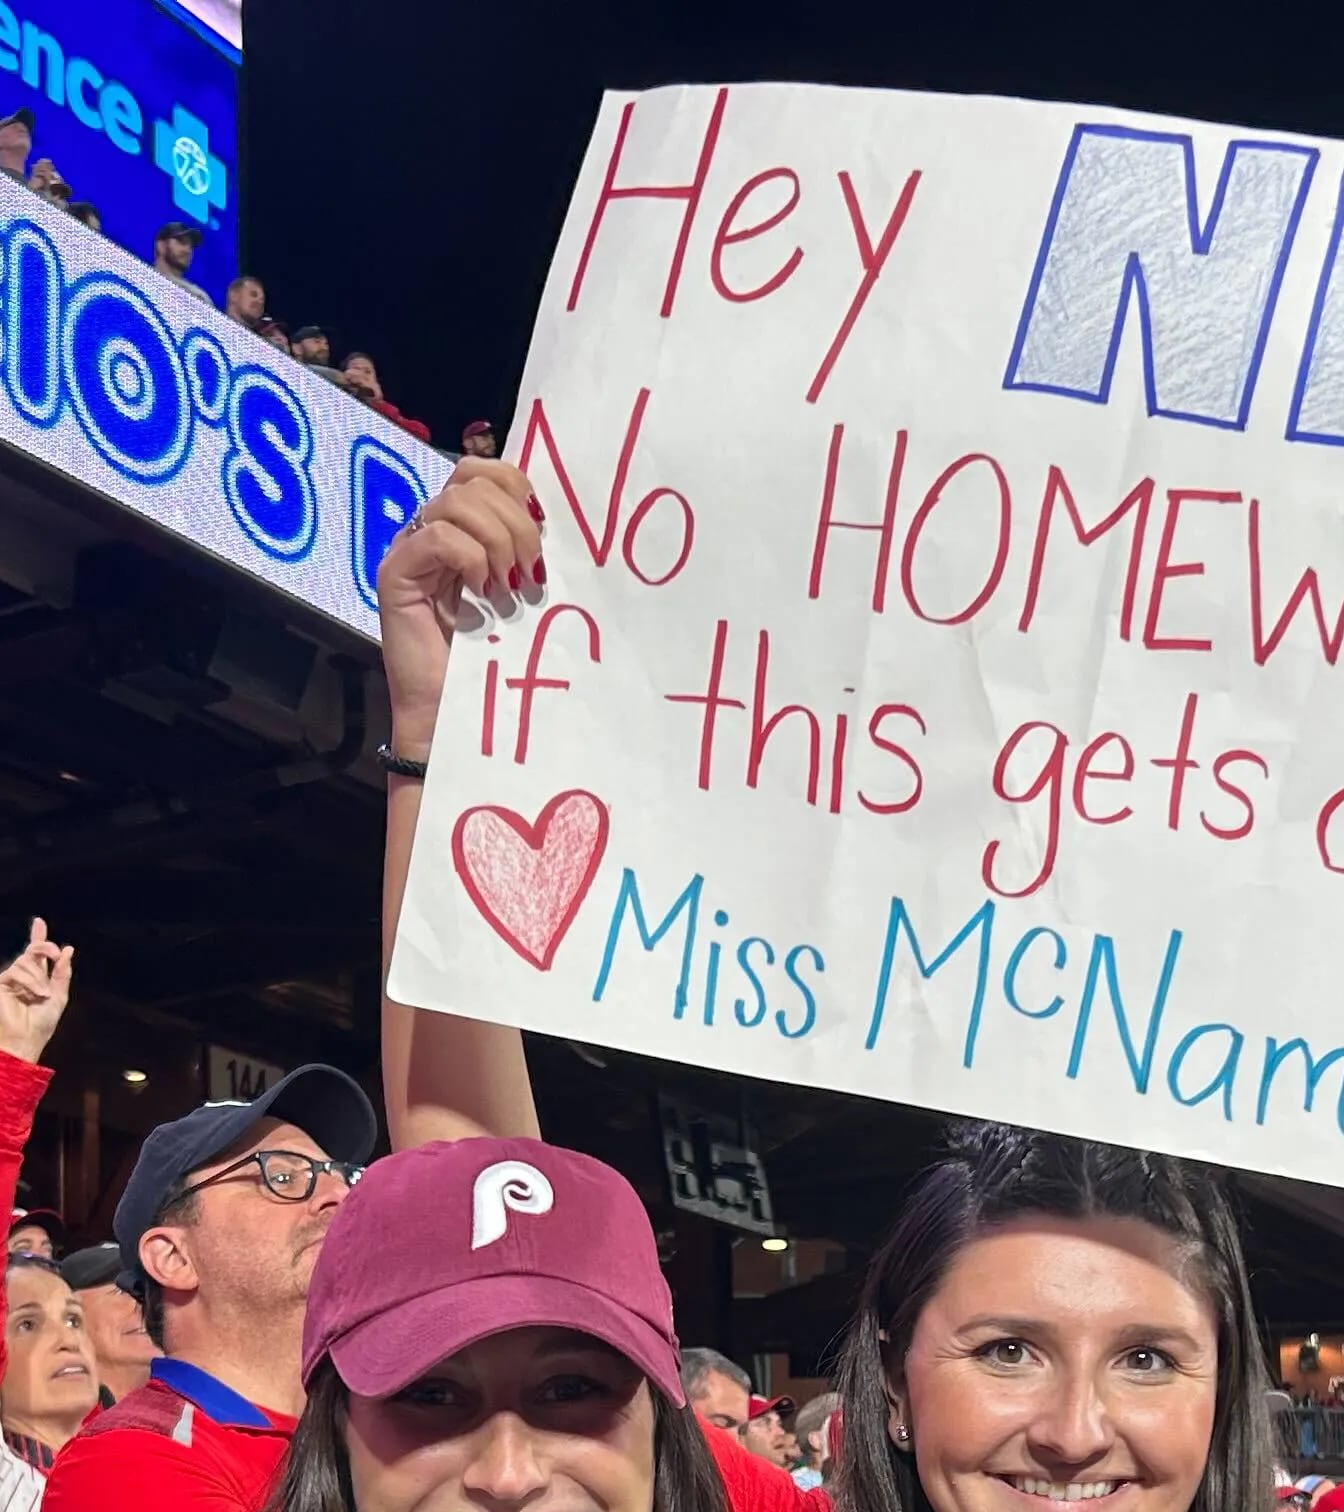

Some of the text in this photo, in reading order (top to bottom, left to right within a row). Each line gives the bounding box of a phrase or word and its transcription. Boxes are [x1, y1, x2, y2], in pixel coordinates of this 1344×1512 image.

[566, 88, 922, 402] Hey
[518, 387, 696, 586] No
[480, 604, 600, 764] if
[664, 619, 926, 815] this
[982, 692, 1268, 898] gets
[592, 868, 826, 1039] Miss
[471, 1160, 554, 1250] P
